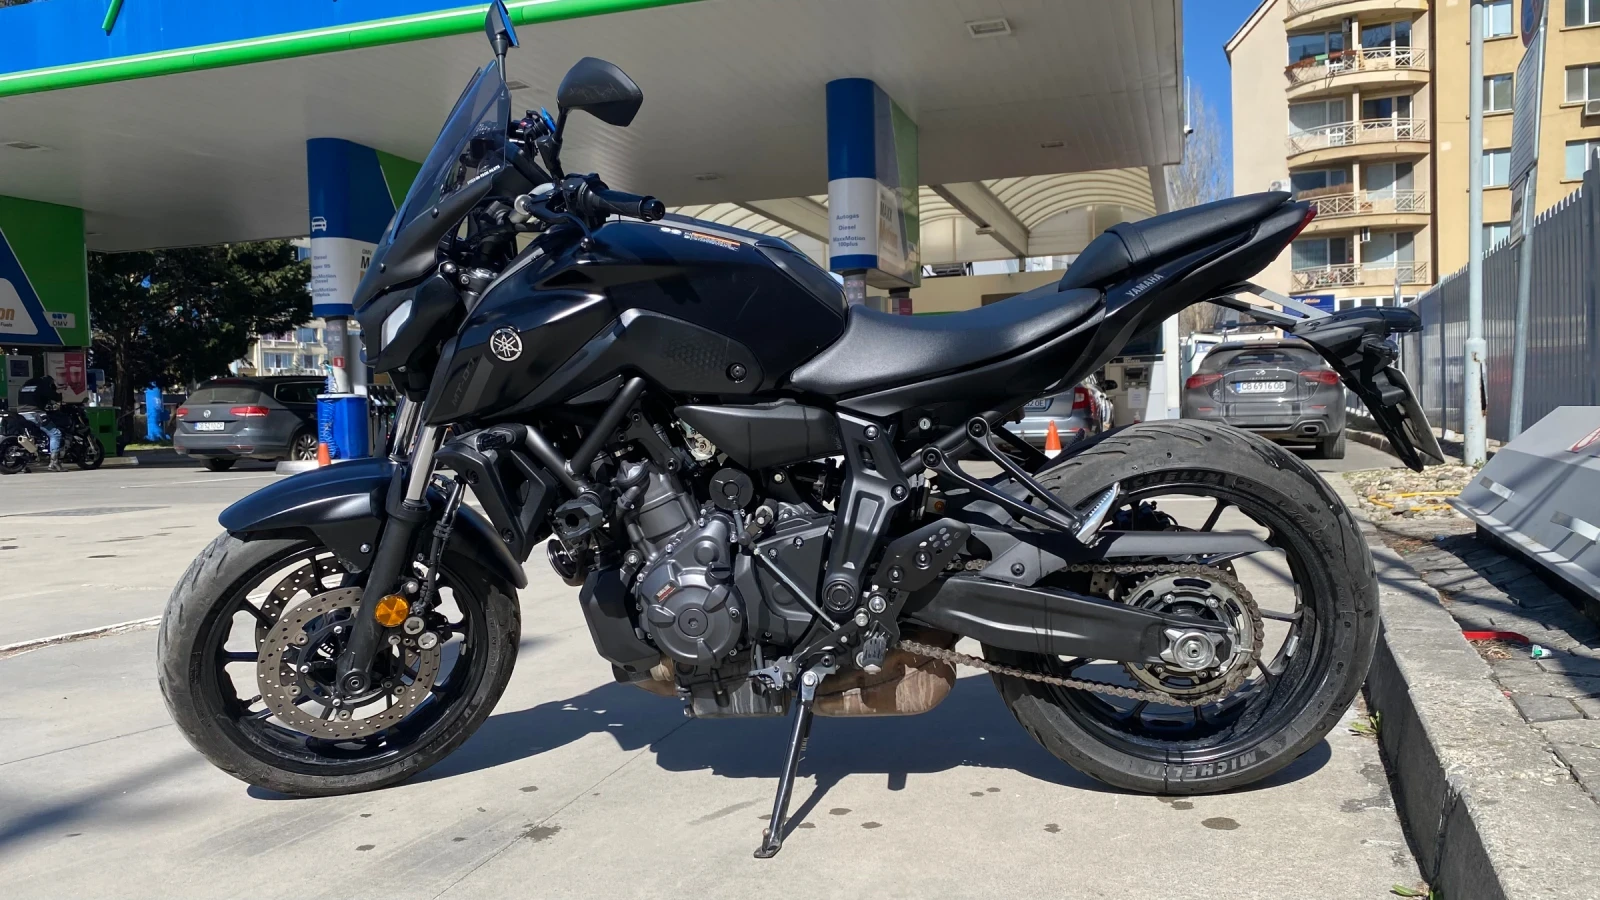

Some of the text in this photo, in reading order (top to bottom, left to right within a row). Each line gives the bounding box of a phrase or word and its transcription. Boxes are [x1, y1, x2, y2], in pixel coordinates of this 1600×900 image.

[1125, 273, 1165, 297] YAMAHA
[452, 356, 476, 406] MT-07
[1241, 382, 1252, 390] CB
[1253, 382, 1272, 390] 6916
[1144, 749, 1257, 778] MICHELIN
